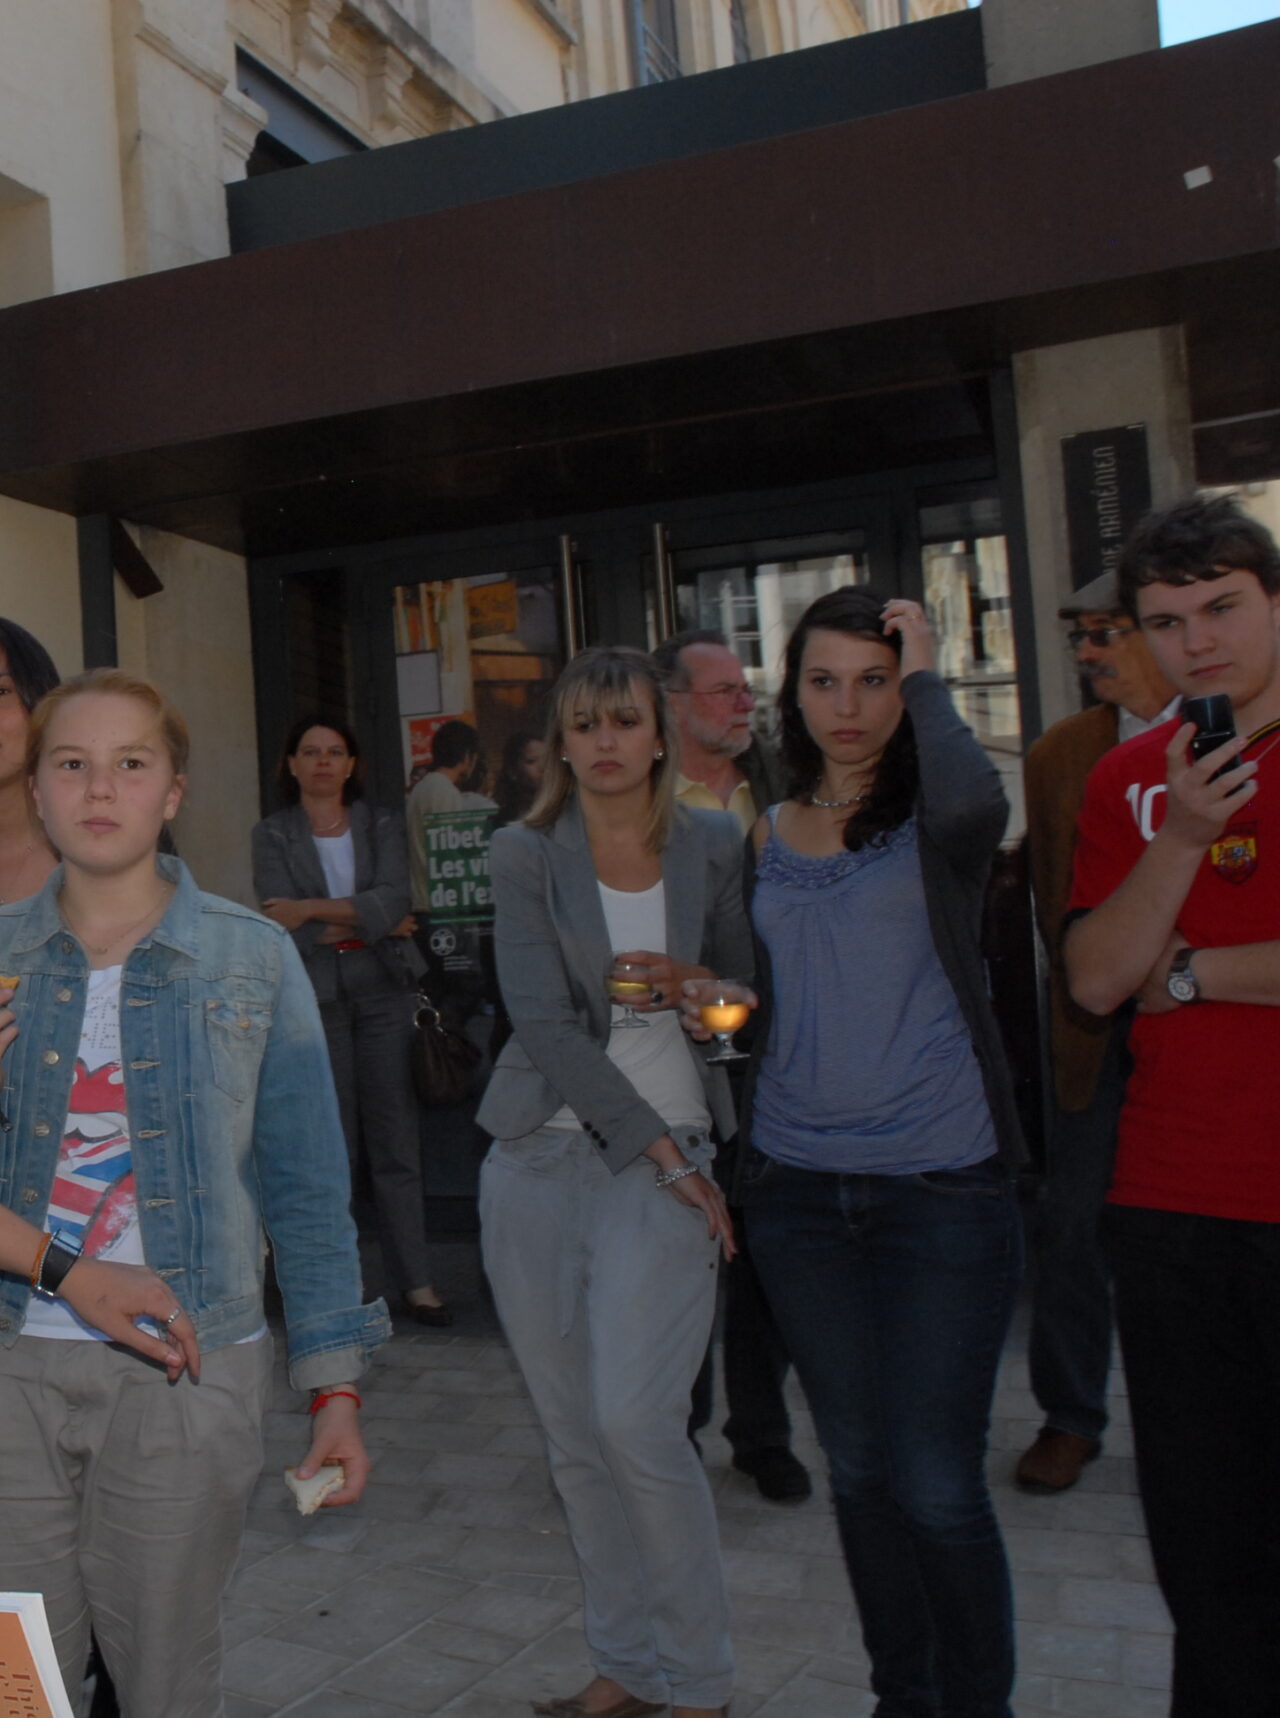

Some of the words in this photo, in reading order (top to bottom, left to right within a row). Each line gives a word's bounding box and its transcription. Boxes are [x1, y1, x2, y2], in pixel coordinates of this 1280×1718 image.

[1090, 445, 1121, 538] ARMÉNIEN
[430, 857, 465, 880] Les
[431, 882, 457, 908] de
